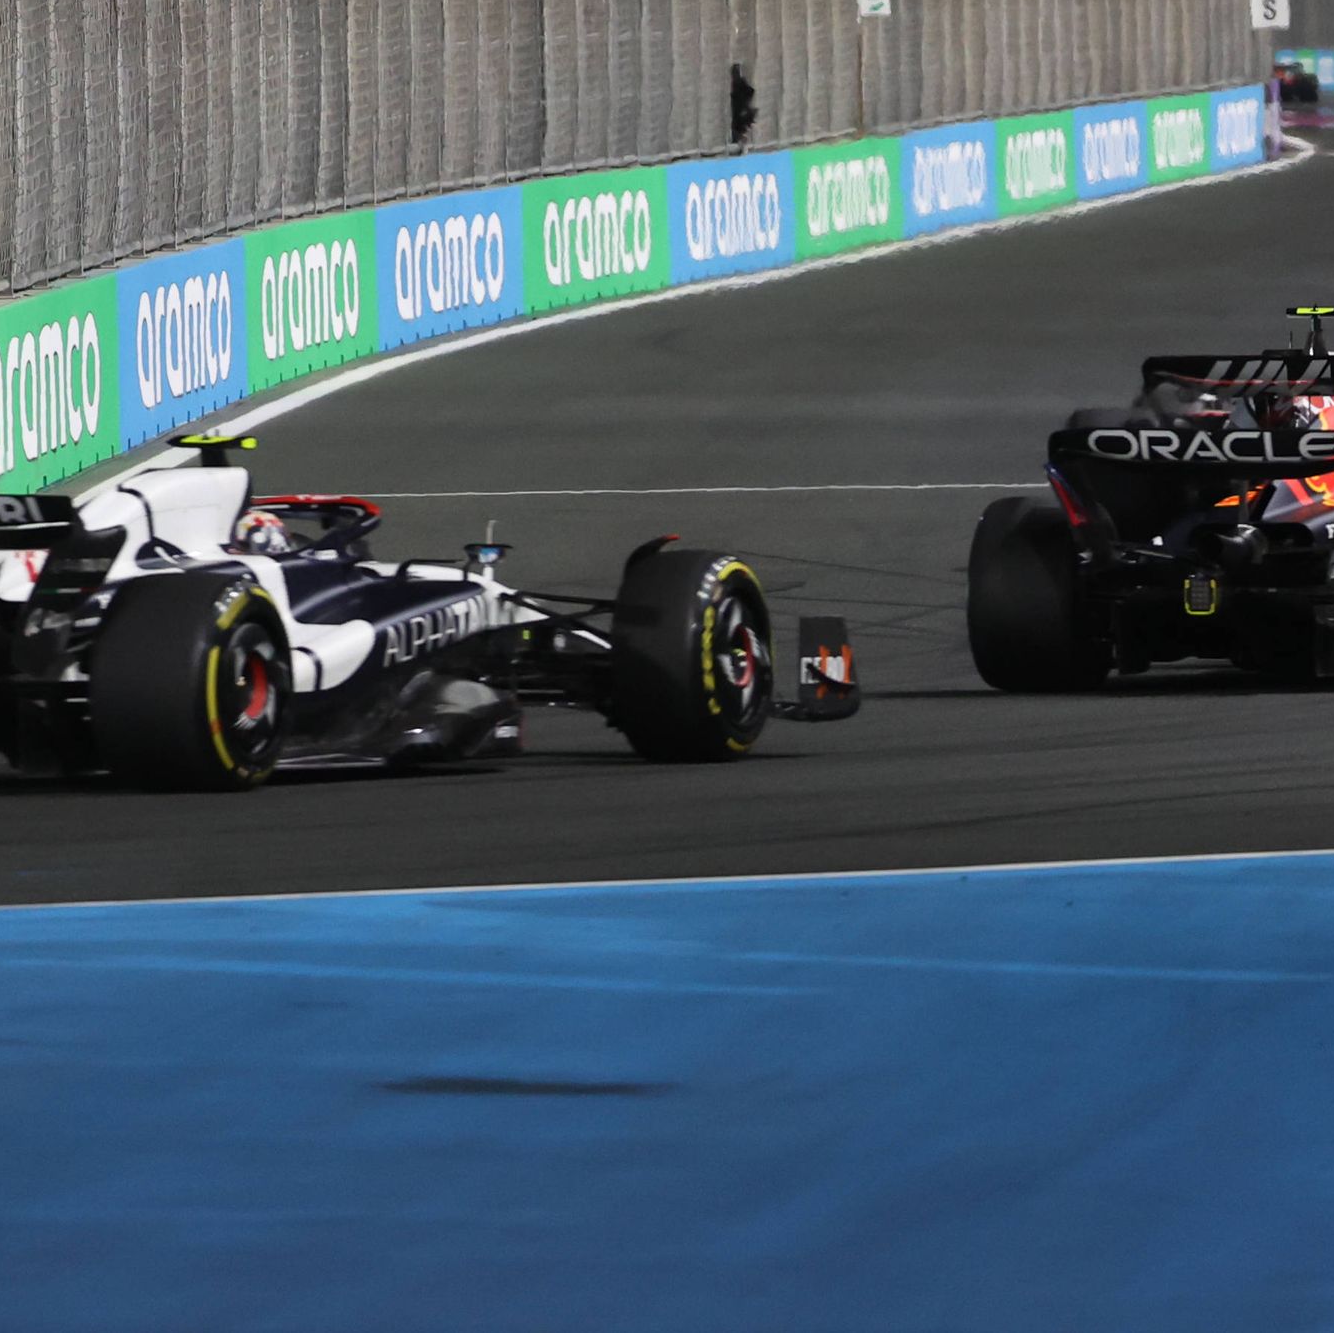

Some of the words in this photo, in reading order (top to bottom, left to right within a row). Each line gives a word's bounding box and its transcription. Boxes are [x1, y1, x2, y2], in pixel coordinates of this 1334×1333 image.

[396, 211, 505, 321] aramco
[544, 189, 652, 287] aramco
[686, 173, 780, 262] aramco
[136, 270, 232, 409] aramco
[262, 237, 360, 360] aramco
